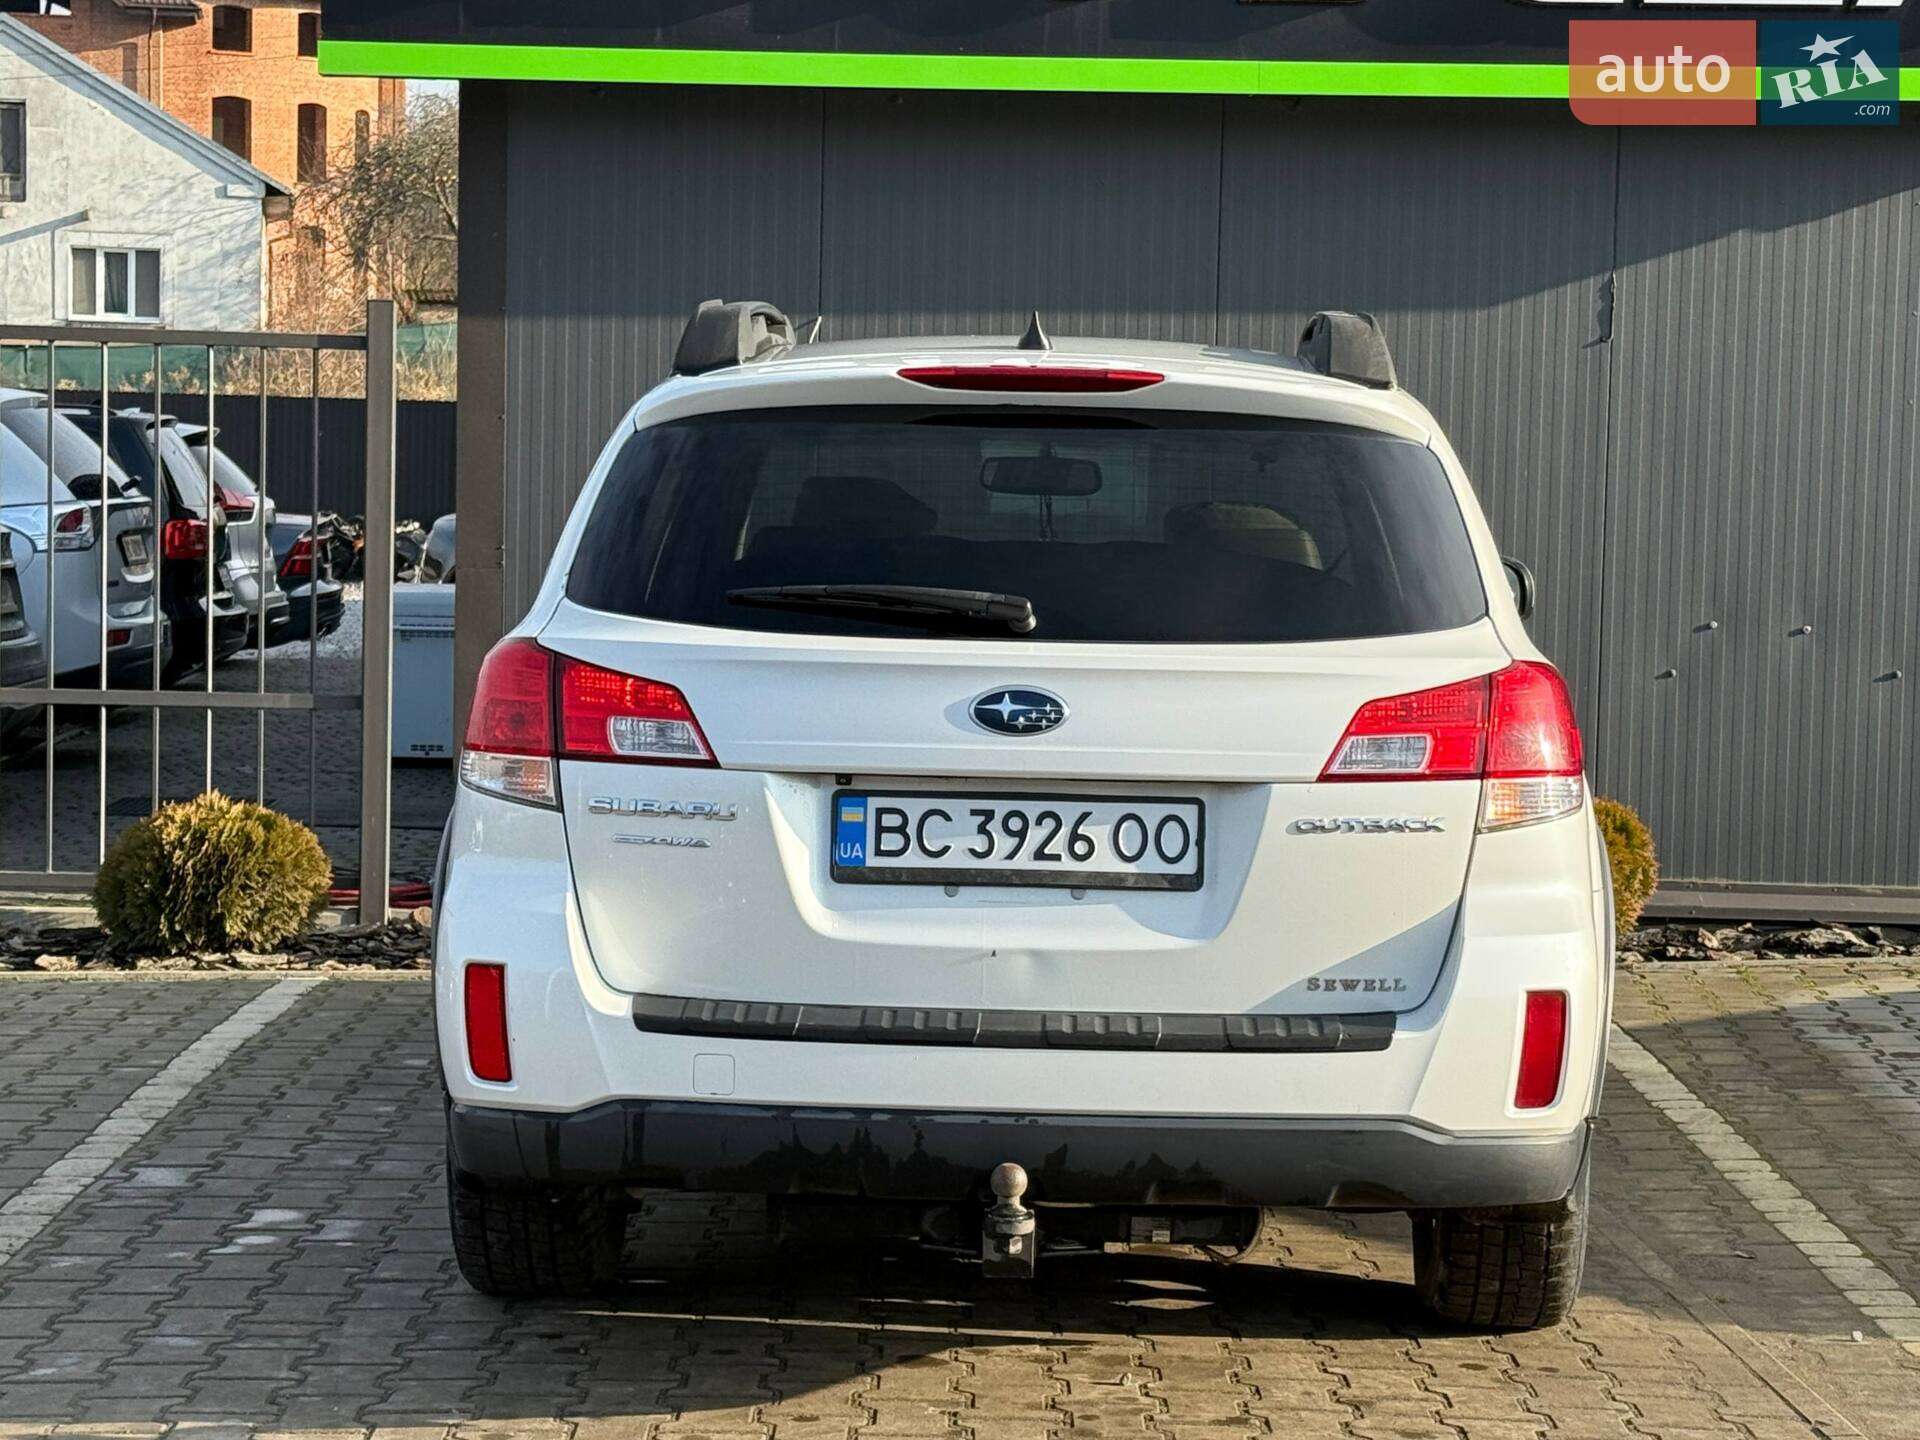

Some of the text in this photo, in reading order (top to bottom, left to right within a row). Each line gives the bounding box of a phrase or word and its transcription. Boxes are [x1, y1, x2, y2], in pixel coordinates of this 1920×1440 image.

[588, 797, 738, 820] SUBARU
[874, 807, 952, 859] BC
[967, 808, 1096, 862] 3926
[1294, 818, 1446, 834] OUTBACK
[840, 842, 863, 859] UA
[1307, 977, 1406, 992] SEWELL
